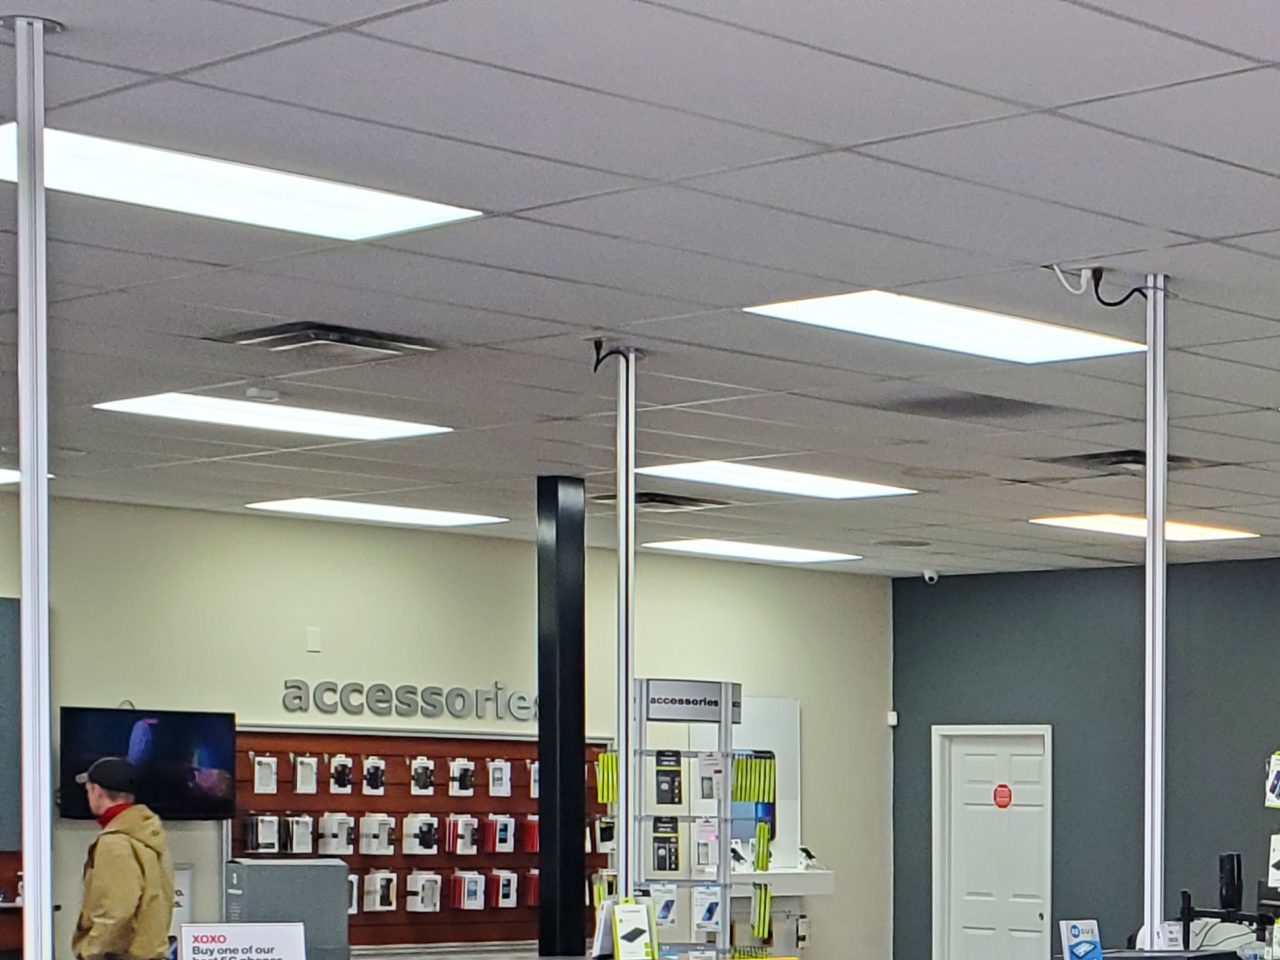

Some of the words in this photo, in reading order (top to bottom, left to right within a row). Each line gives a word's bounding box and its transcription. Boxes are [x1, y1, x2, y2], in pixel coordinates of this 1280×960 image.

[282, 679, 539, 722] accessorie
[650, 697, 719, 707] accessories
[192, 934, 227, 944] XOXO
[192, 945, 215, 956] Buy
[241, 945, 253, 954] of
